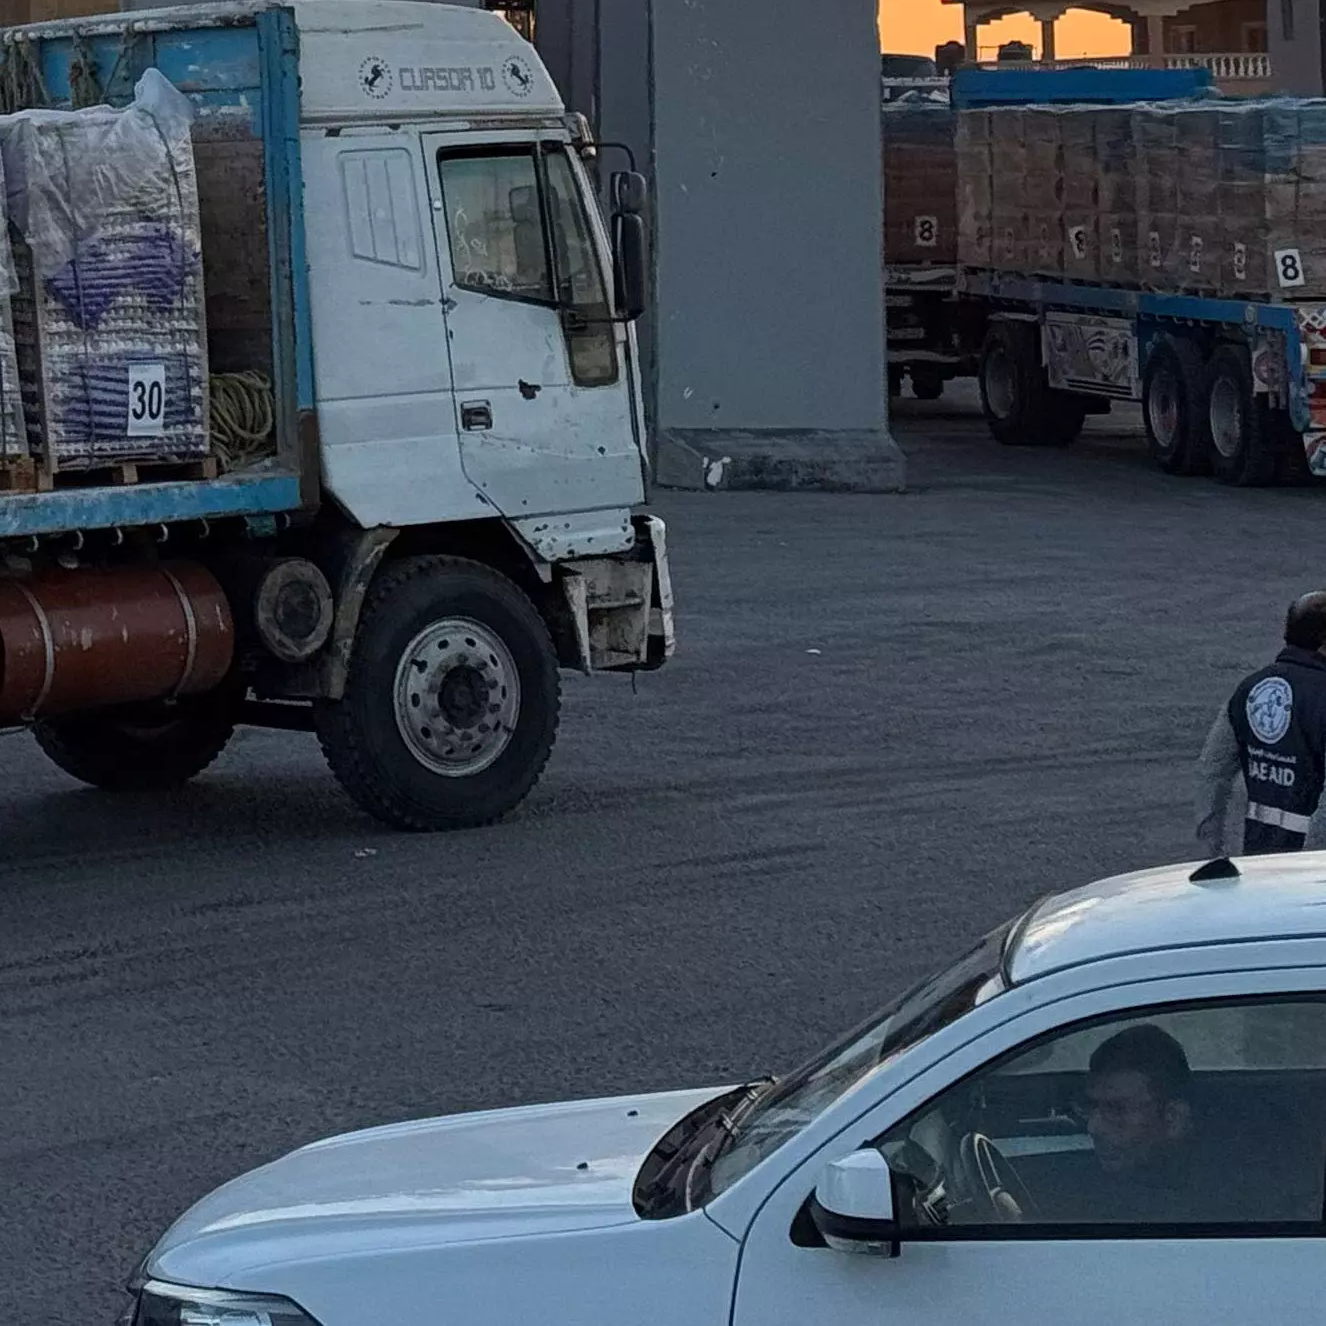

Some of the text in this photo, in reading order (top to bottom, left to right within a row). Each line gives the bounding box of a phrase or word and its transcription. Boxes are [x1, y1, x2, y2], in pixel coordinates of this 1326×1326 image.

[399, 67, 496, 91] CURSOR 10
[919, 220, 934, 242] 8
[1281, 254, 1300, 281] 8
[132, 380, 163, 421] 30
[1268, 764, 1296, 787] AID
